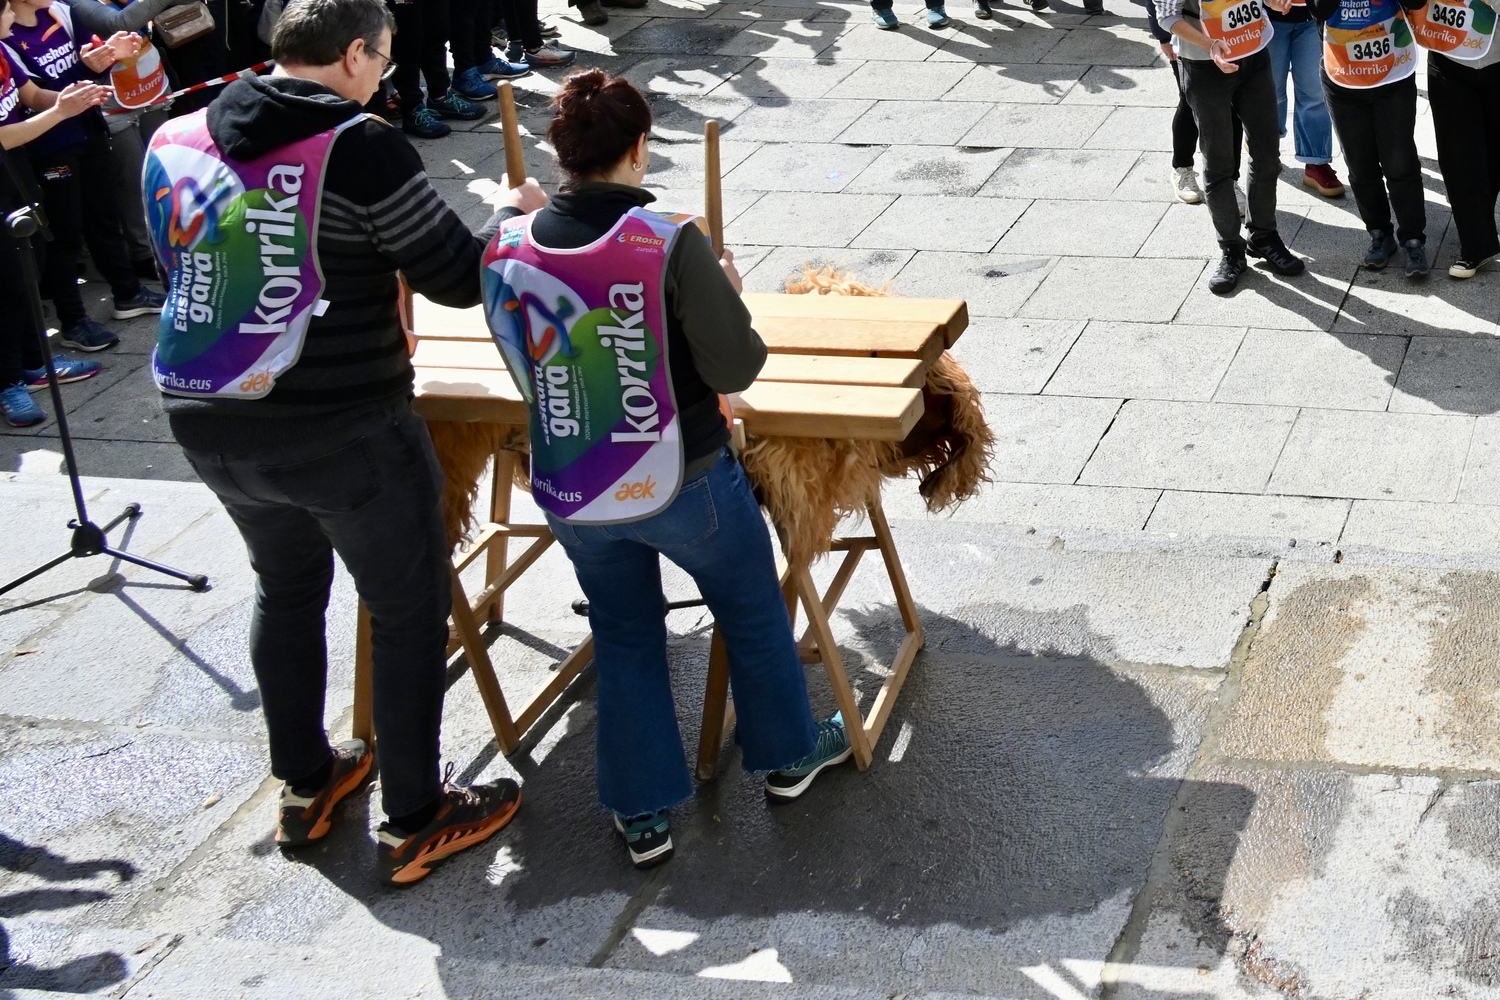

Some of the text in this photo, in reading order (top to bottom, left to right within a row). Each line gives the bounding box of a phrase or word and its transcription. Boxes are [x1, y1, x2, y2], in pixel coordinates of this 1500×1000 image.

[1228, 0, 1261, 28] 3436
[1339, 0, 1370, 8] Euskara
[1341, 6, 1371, 21] gara
[1433, 4, 1466, 28] 3436
[1223, 28, 1262, 48] korrika
[1354, 38, 1390, 60] 3436
[1410, 22, 1484, 50] 24.korrika aek
[1334, 49, 1412, 77] 24.korrika aek
[238, 163, 304, 334] korrika
[630, 235, 664, 246] EROSKI
[172, 252, 192, 332] Euskara
[190, 251, 213, 324] gara
[596, 282, 662, 444] korrika
[156, 366, 274, 393] korrika.eus aek
[546, 366, 580, 437] gara
[573, 384, 581, 420] Atharratzetik
[533, 474, 656, 504] korrika.eus aek
